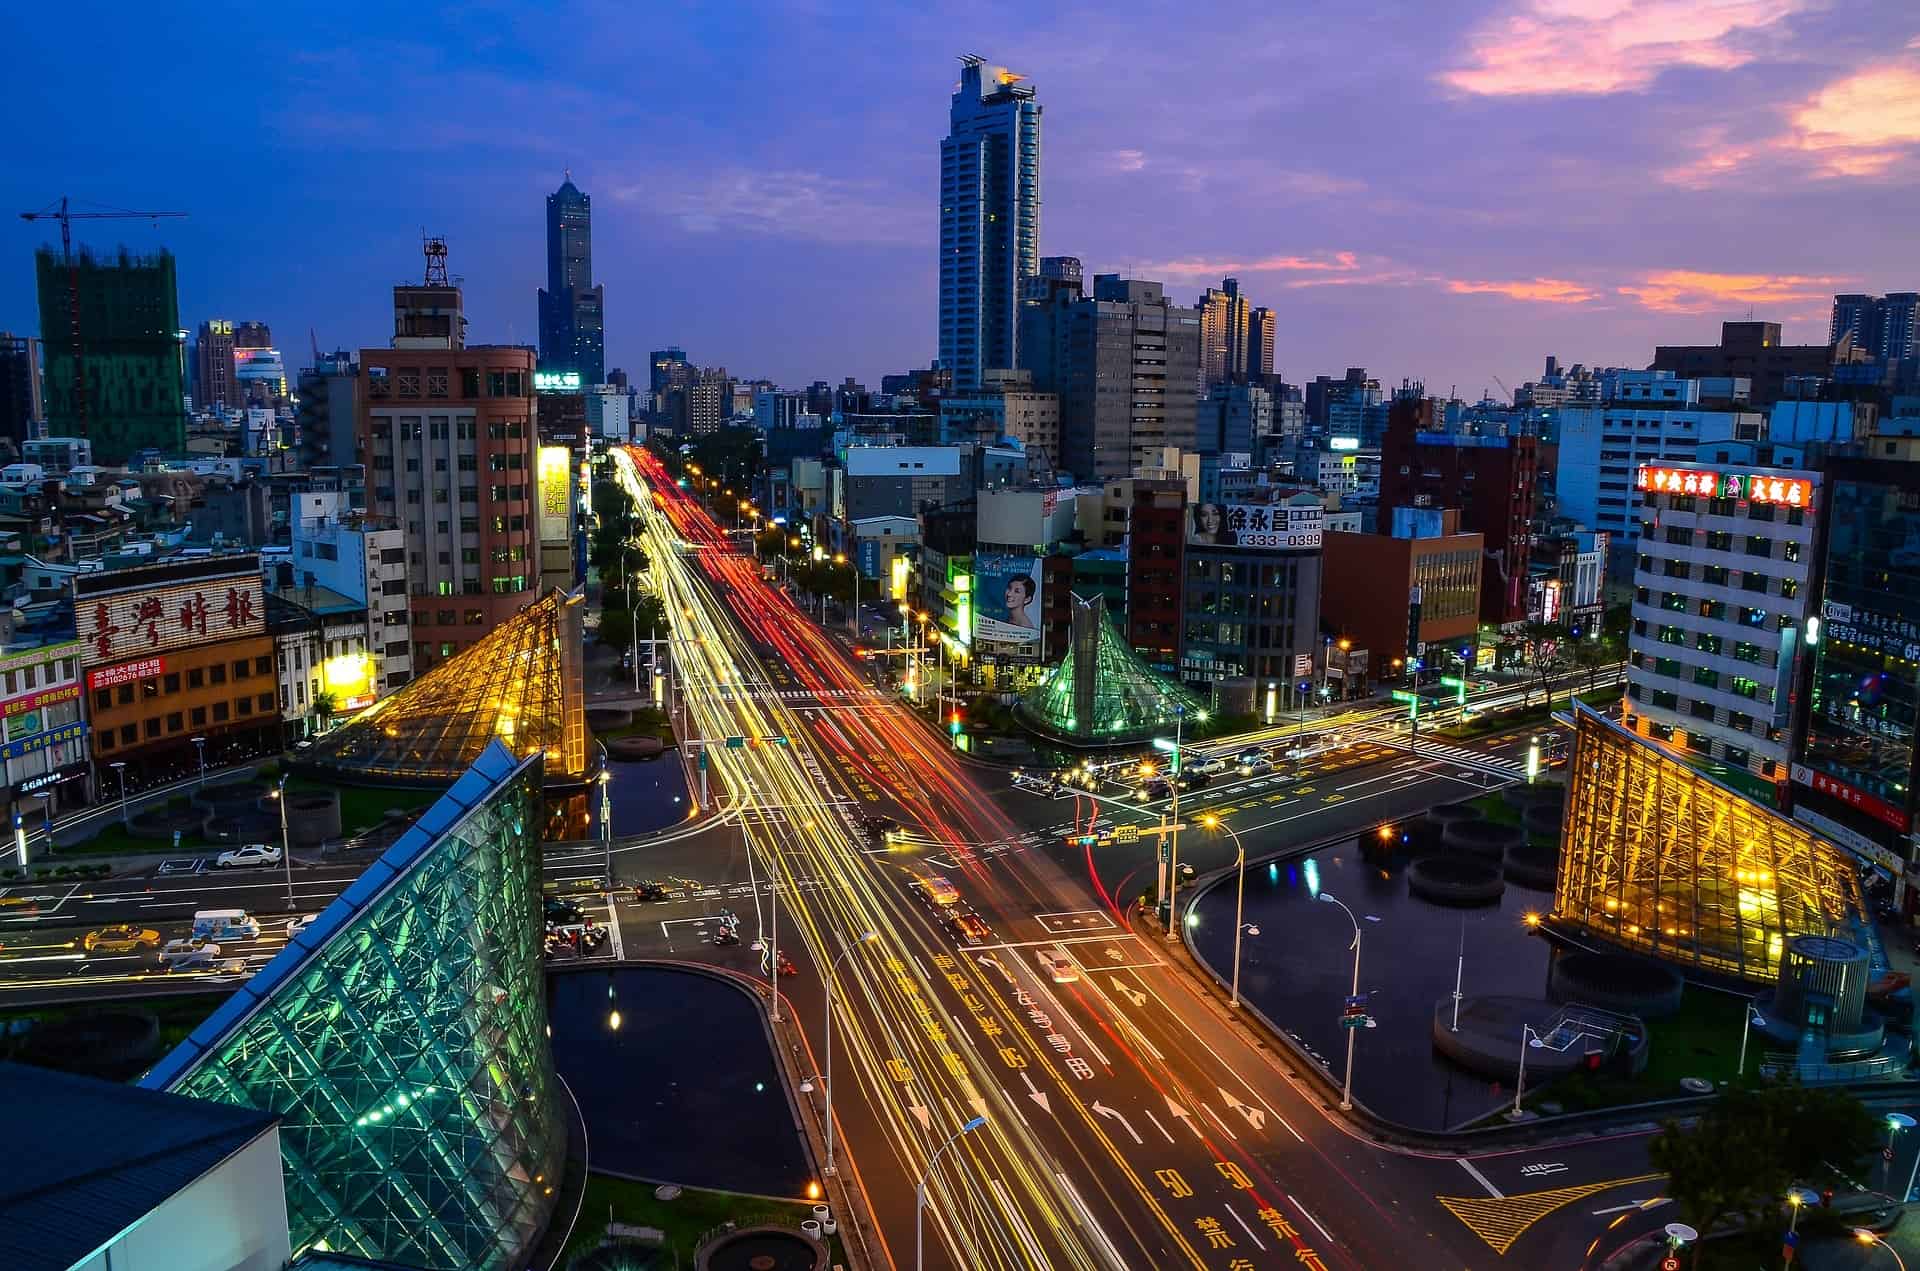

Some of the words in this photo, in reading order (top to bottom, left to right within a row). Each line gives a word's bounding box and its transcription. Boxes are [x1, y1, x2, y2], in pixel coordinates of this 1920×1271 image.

[1752, 479, 1801, 503] 大飯店
[1227, 506, 1288, 532] 徐永昌
[1246, 534, 1320, 546] 333-0399
[87, 587, 262, 657] 臺灣時報
[1000, 1047, 1028, 1069] 50
[1155, 1168, 1194, 1198] 50
[1214, 1161, 1254, 1190] 50
